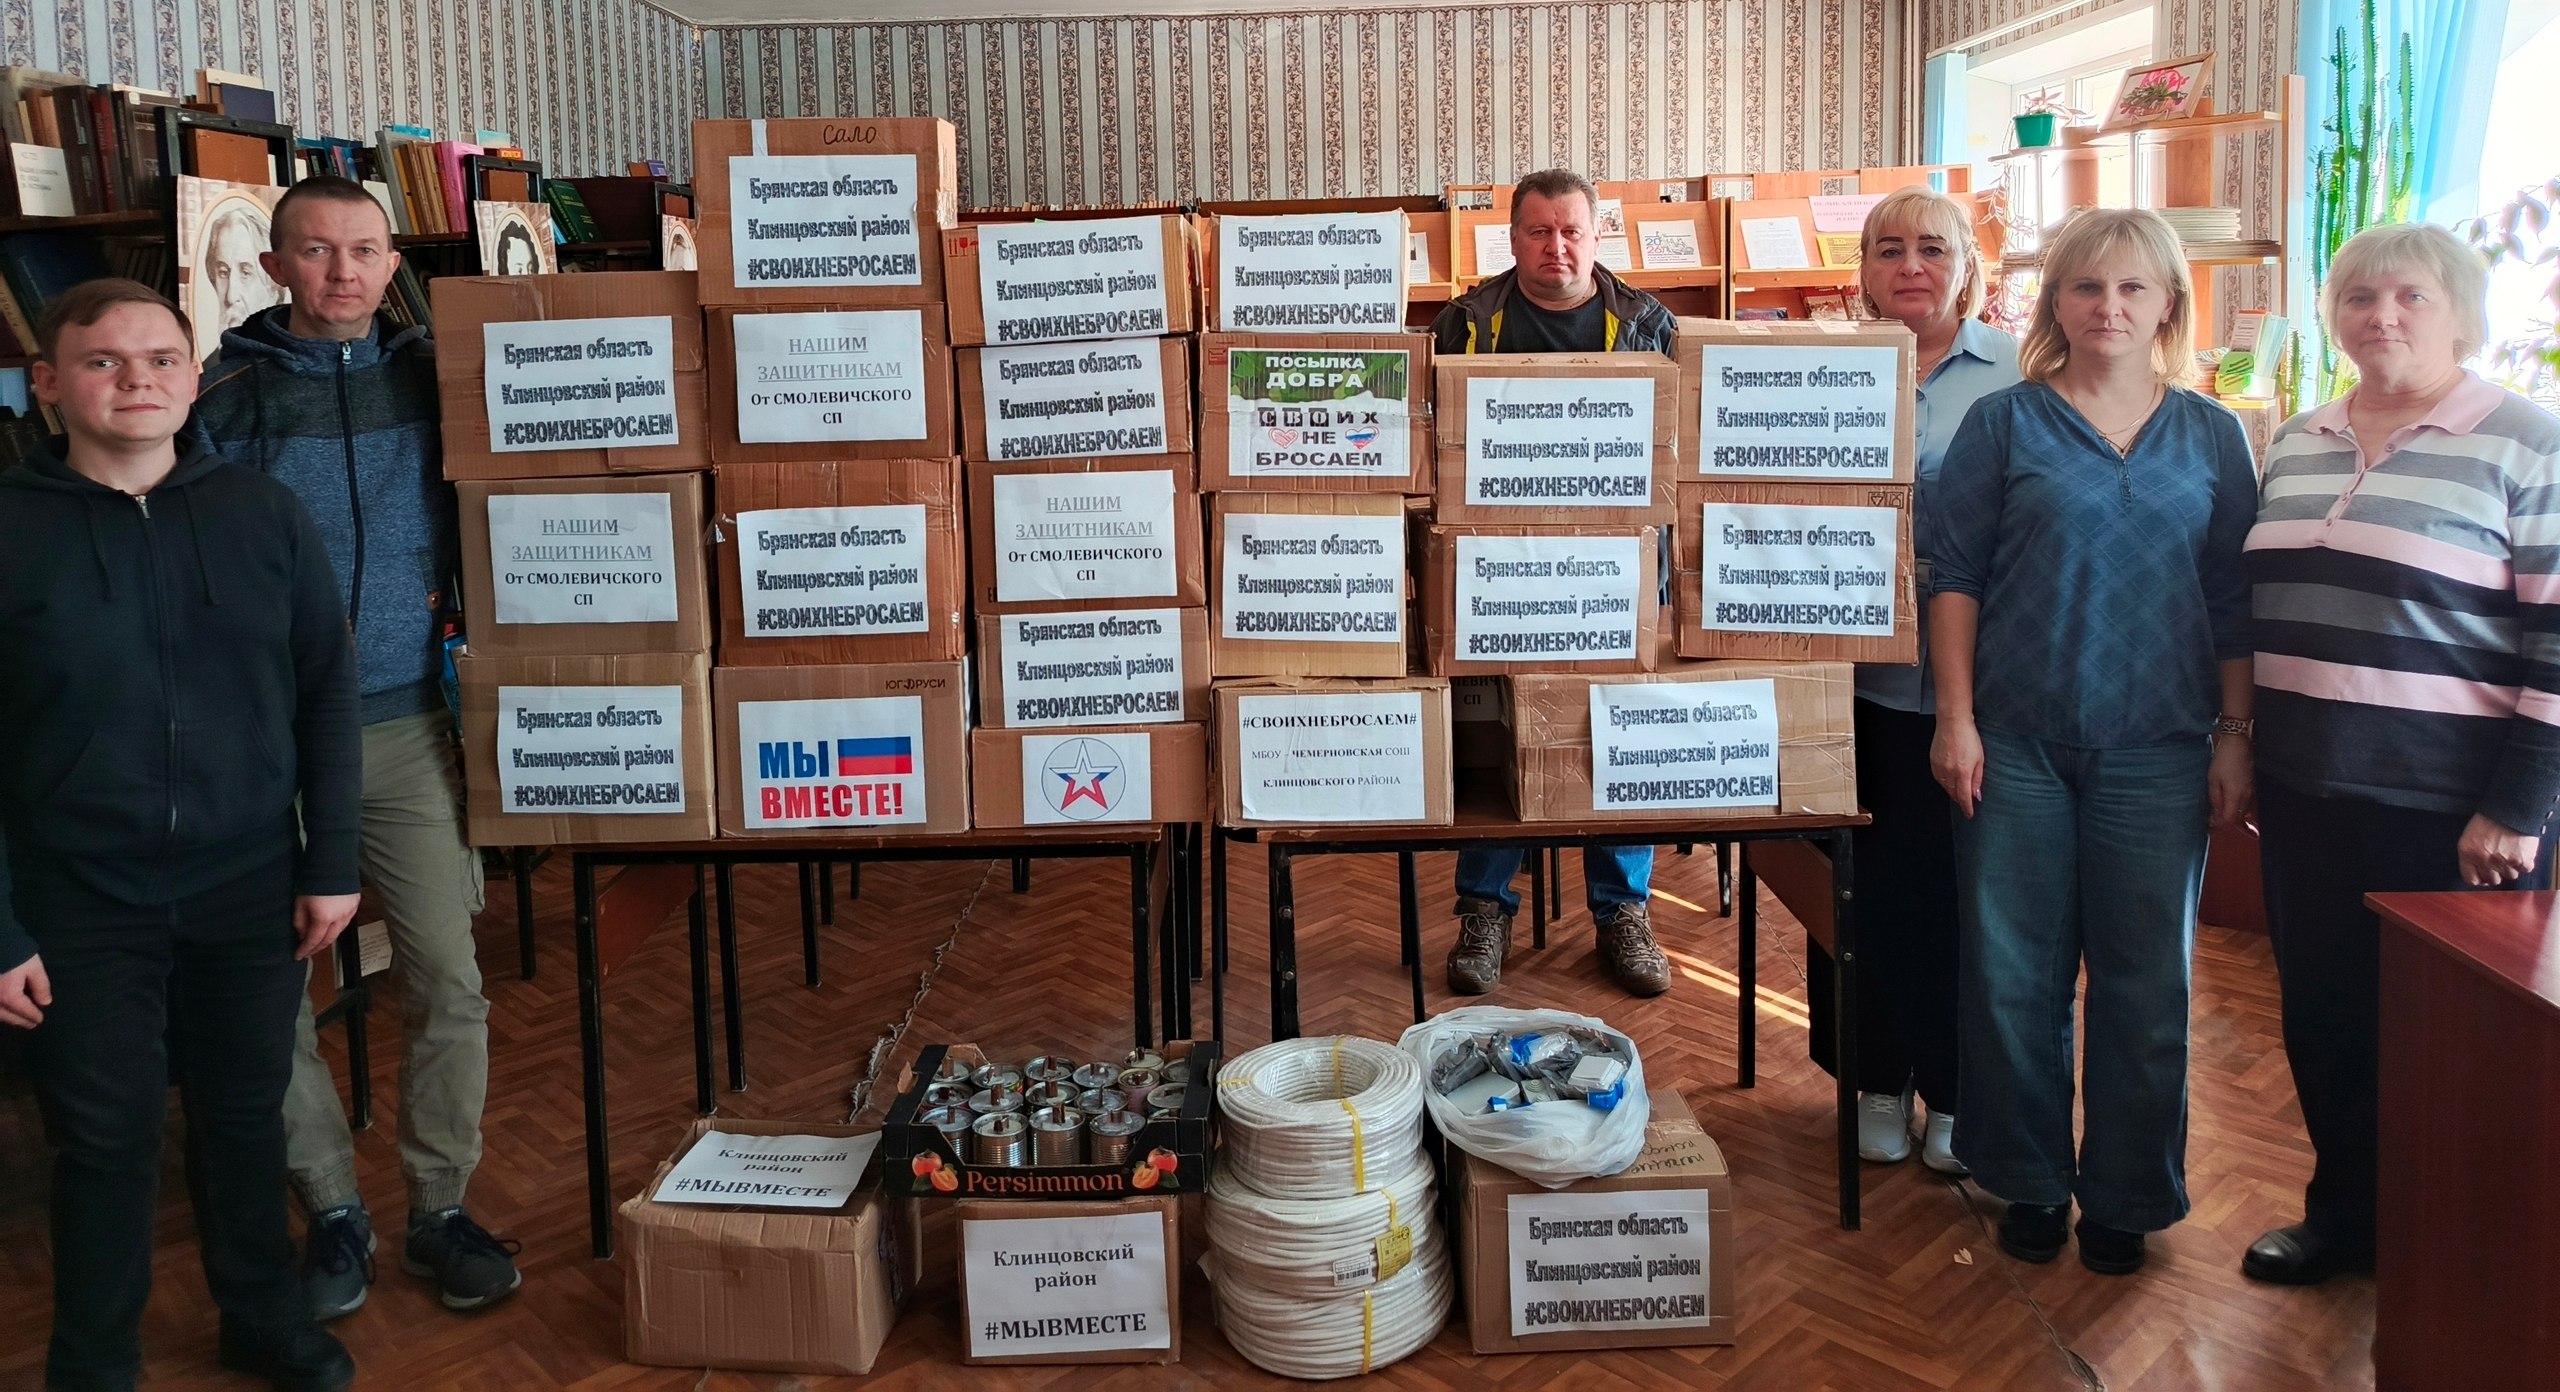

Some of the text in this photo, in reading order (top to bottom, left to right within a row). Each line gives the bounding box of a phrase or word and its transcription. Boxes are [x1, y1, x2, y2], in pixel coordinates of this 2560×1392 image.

[824, 125, 876, 145] Сало
[750, 174, 898, 204] Брянская область
[748, 214, 910, 242] Клинцовский район
[1238, 224, 1381, 252] Брянская область
[997, 232, 1143, 265] Брянская область
[748, 254, 916, 280] #СВОИХНЕБРОСАЕМ
[1235, 263, 1392, 290] Клинцовский район
[996, 270, 1156, 301] Клинцовский район
[998, 309, 1163, 341] #СВОИХНЕБРОСАЕМ
[1233, 303, 1395, 326] #СВОИХНЕБРОСАЕМ
[504, 337, 653, 369] Брянская область
[789, 337, 868, 355] НАШИМ
[758, 363, 902, 382] ЗАЩИТНИКАМ
[999, 352, 1142, 384] Брянская область
[1266, 357, 1365, 370] ПОСЫЛКА
[501, 376, 665, 405] Клинцовский район
[1267, 372, 1363, 388] ДОБРА
[1722, 365, 1875, 393] Брянская область
[751, 389, 911, 405] От СМОЛЕВИЧСКОГО
[999, 389, 1155, 420] Клинцовский район
[823, 413, 842, 424] СП
[1486, 397, 1633, 424] Брянская область
[1717, 406, 1886, 433] Клинцовский район
[504, 414, 673, 445] #СВОИХНЕБРОСАЕМ
[1000, 426, 1162, 459] #СВОИХНЕБРОСАЕМ
[1303, 431, 1336, 444] НЕ
[1256, 452, 1381, 466] БРОСАЕМ
[1482, 437, 1643, 463] Клинцовский район
[1714, 446, 1888, 467] #СВОИХНЕБРОСАЕМ
[1479, 476, 1646, 498] #СВОИХНЕБРОСАЕМ
[1046, 496, 1121, 513] НАШИМ
[542, 519, 619, 535] НАШИМ
[758, 525, 906, 555] Брянская область
[1016, 522, 1152, 540] ЗАЩИТНИКАМ
[1723, 524, 1875, 550] Брянская область
[512, 546, 652, 562] ЗАЩИТНИКАМ
[1009, 548, 1162, 562] От СМОЛЕВИЧСКОГО
[1242, 534, 1383, 560] Брянская область
[505, 572, 661, 584] От СМОЛЕВИЧСКОГО
[757, 564, 917, 592] Клинцовский район
[1077, 570, 1095, 581] СП
[1475, 555, 1620, 583] Брянская область
[1719, 564, 1885, 591] Клинцовский район
[1238, 573, 1393, 599] Клинцовский район
[574, 594, 592, 605] СП
[1472, 594, 1629, 619] Клинцовский район
[757, 601, 923, 630] #СВОИХНЕБРОСАЕМ
[1236, 611, 1396, 632] #СВОИХНЕБРОСАЕМ
[1716, 602, 1888, 625] #СВОИХНЕБРОСАЕМ
[1019, 616, 1162, 646] Брянская область
[1469, 630, 1631, 654] #СВОИХНЕБРОСАЕМ
[1017, 653, 1173, 682] Клинцовский район
[1017, 691, 1179, 720] #СВОИХНЕБРОСАЕМ
[1609, 701, 1757, 731] Брянская область
[517, 705, 662, 734] Брянская область
[1243, 713, 1416, 728] #СВОИХНЕБРОСАЕМ#
[513, 744, 674, 771] Клинцовский район
[759, 741, 829, 779] МЫ
[1252, 750, 1281, 759] МБОУ
[1292, 747, 1383, 758] ЧЕМЕРНОВСКАЯ
[1385, 747, 1410, 756] СОШ
[1608, 739, 1769, 767] Клинцовский район
[514, 782, 680, 806] #СВОИХНЕБРОСАЕМ
[1263, 775, 1400, 788] КЛИНЦОВСКОГО РАЙОНА
[1606, 775, 1773, 802] #СВОИХНЕБРОСАЕМ
[761, 783, 902, 819] ВМЕСТЕ!
[718, 1149, 847, 1163] Клинцовский
[744, 1162, 803, 1174] район
[675, 1178, 831, 1196] #МЫВМЕСТЕ
[966, 1170, 1124, 1194] Persimmon
[1529, 1212, 1688, 1245] Брянская область
[994, 1244, 1134, 1266] Клинцовский
[1035, 1272, 1096, 1292] район
[1526, 1254, 1700, 1285] Клинцовский район
[1525, 1295, 1704, 1326] #СВОИХНЕБРОСАЕМ
[985, 1313, 1146, 1340] #МЫВМЕСТЕ
